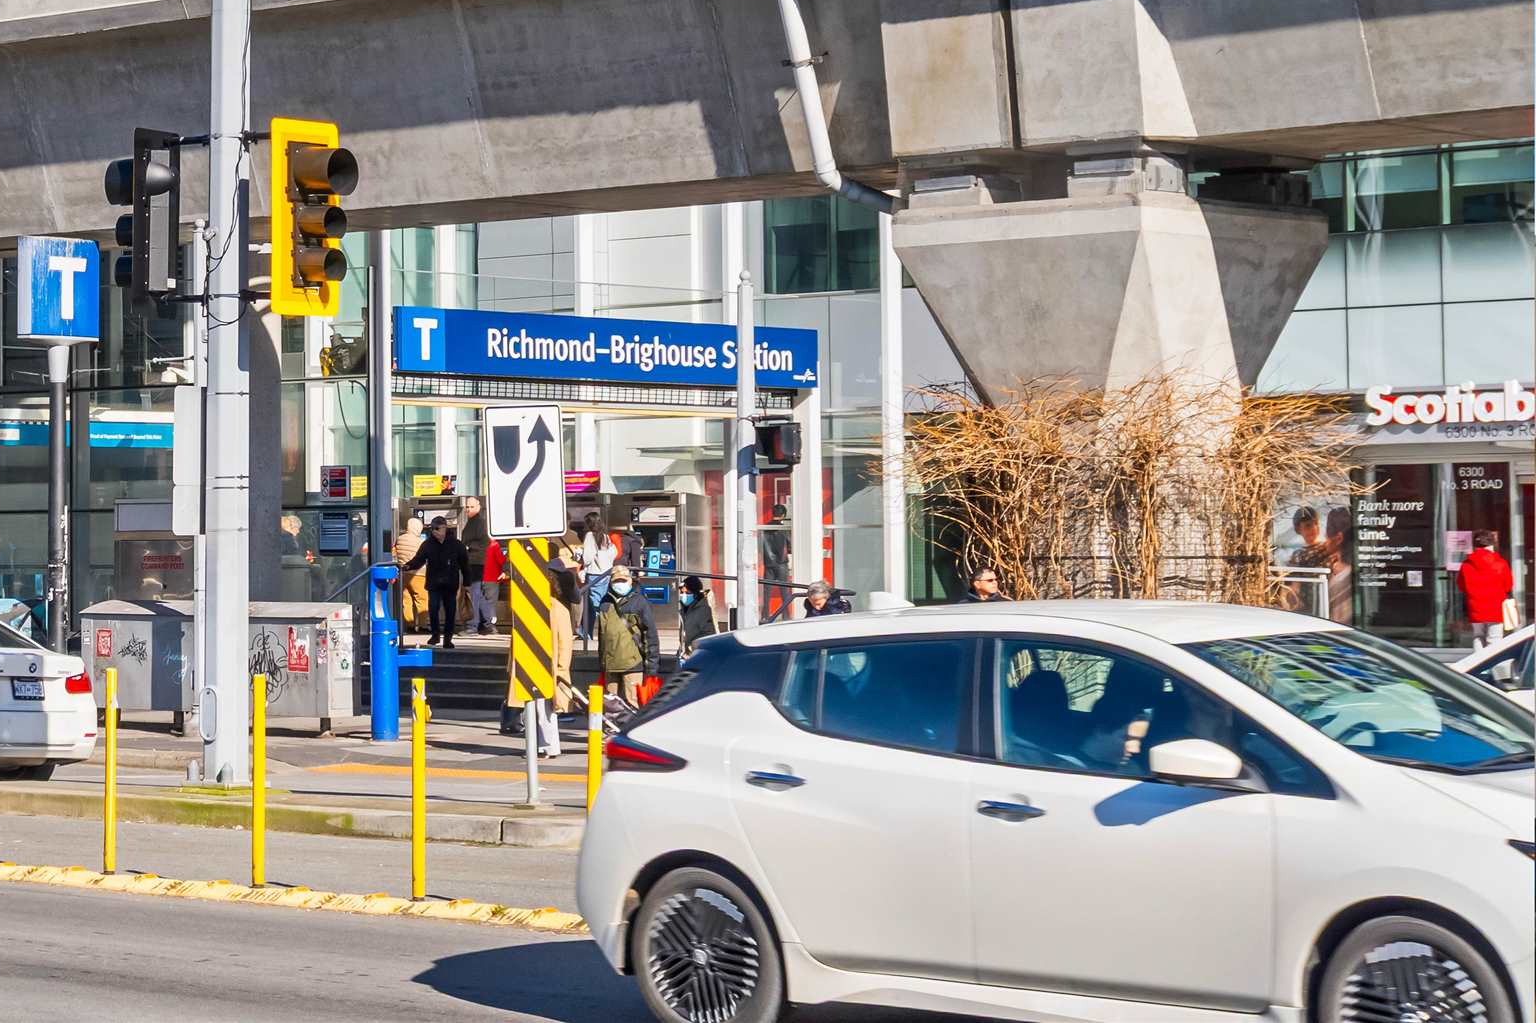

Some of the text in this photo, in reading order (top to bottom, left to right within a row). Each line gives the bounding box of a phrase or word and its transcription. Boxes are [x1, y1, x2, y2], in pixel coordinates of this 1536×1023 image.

[48, 256, 87, 320] T
[413, 318, 438, 361] T
[722, 340, 793, 371] Stion
[1365, 379, 1535, 426] Scotiab
[1459, 467, 1484, 477] 6300
[1462, 480, 1468, 489] 3
[1471, 479, 1503, 489] ROAD
[1358, 500, 1424, 511] Bank more
[1358, 514, 1396, 528] family
[1358, 529, 1390, 540] time.
